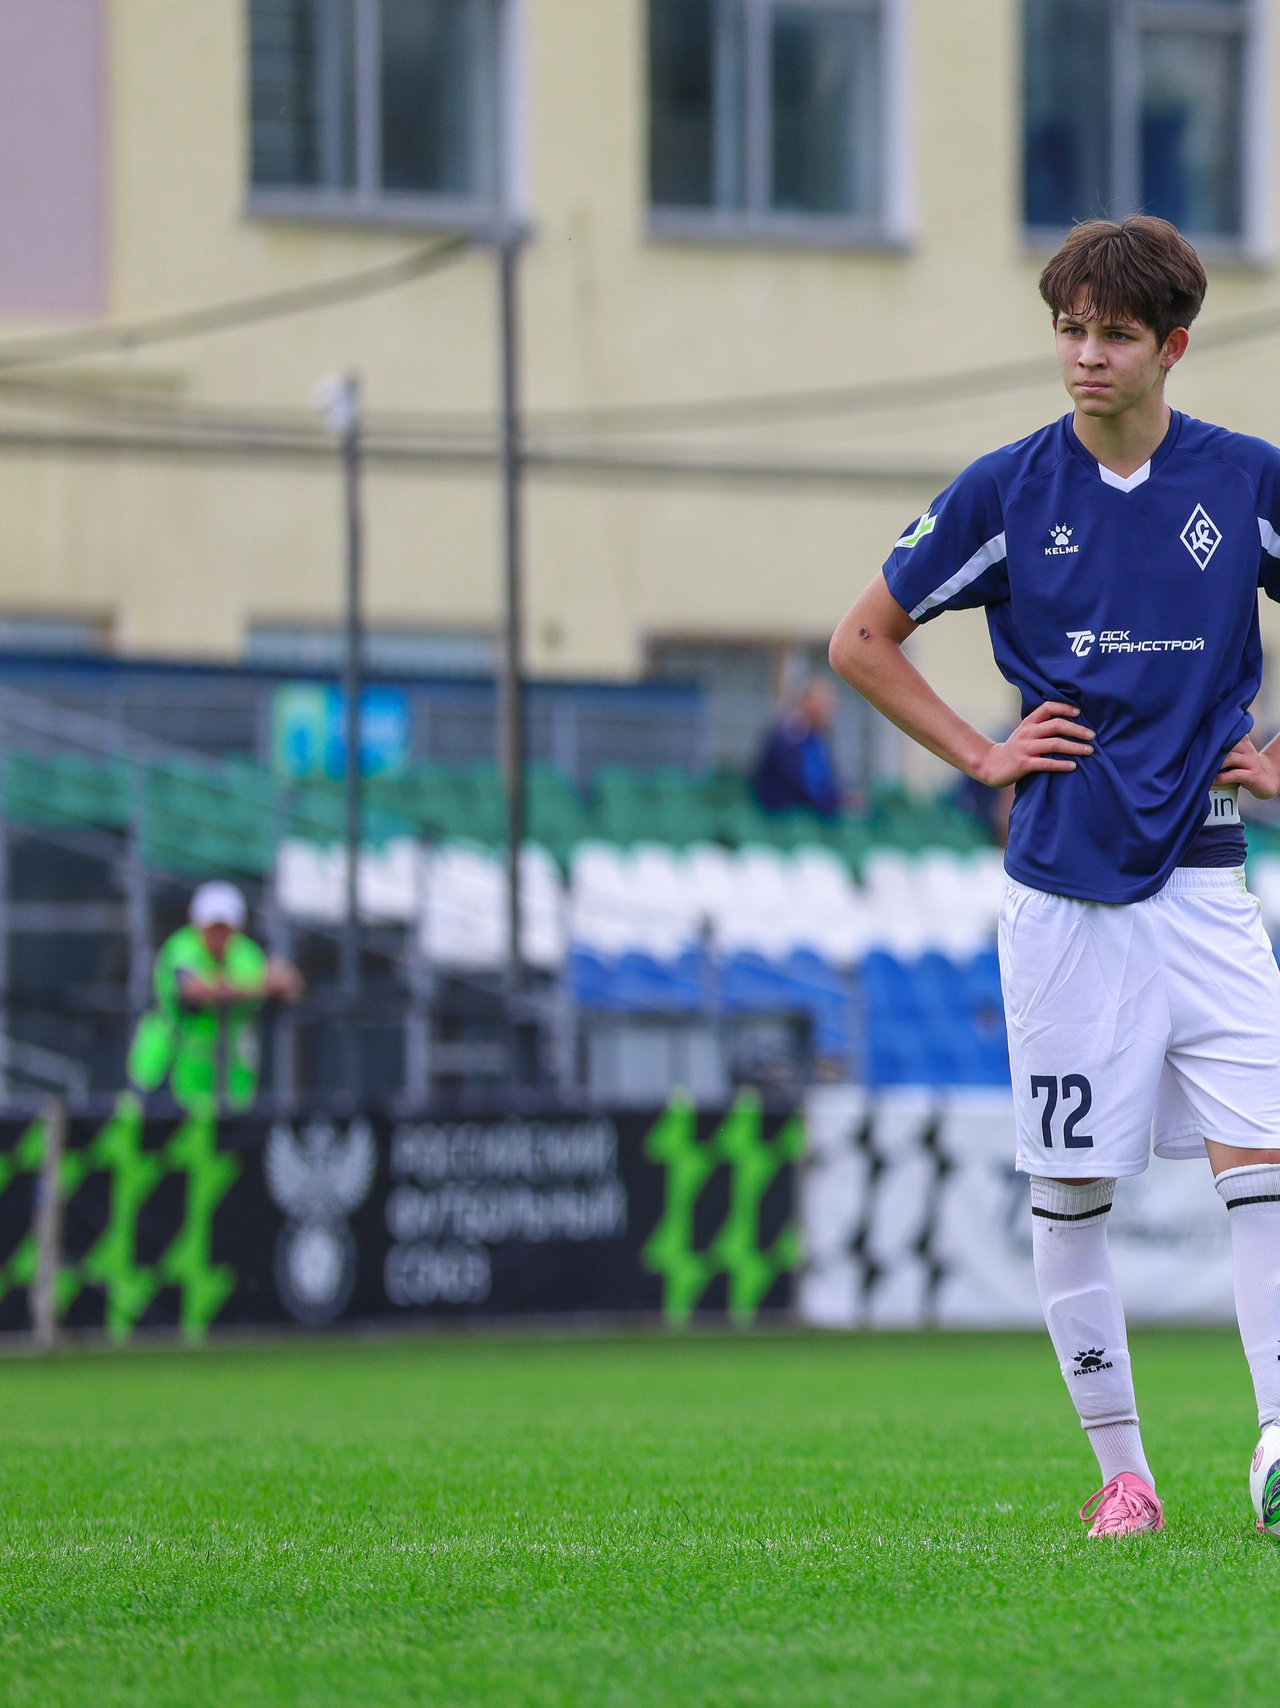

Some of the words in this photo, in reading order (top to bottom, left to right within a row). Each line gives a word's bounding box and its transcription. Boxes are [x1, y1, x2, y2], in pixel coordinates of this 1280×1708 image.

[1044, 545, 1080, 556] KELME
[1099, 630, 1131, 642] ДСК
[1099, 637, 1205, 653] ТРАНССТРОЙ
[1030, 1073, 1094, 1149] 72
[1073, 1361, 1113, 1376] KELME
